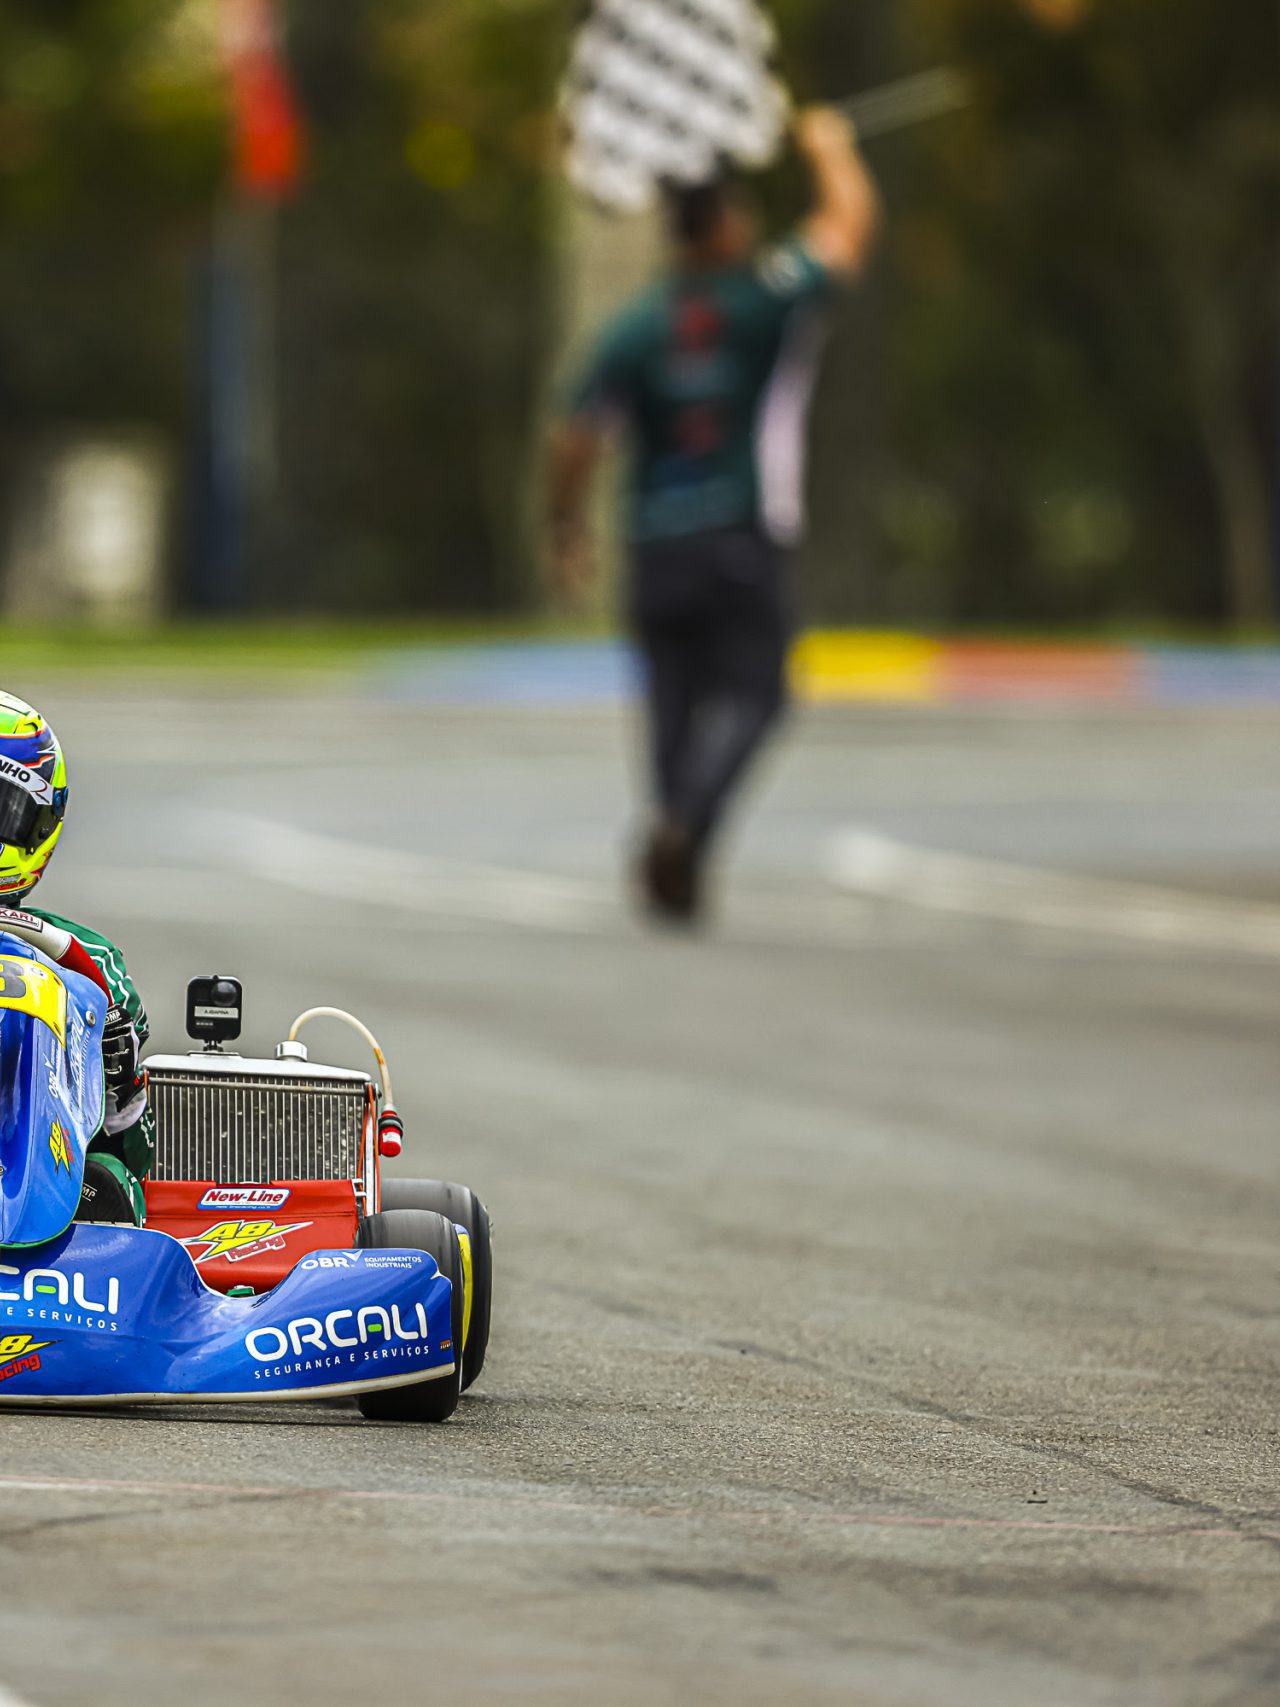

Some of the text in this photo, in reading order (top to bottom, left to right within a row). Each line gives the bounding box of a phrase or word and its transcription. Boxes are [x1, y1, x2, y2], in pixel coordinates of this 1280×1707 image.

[205, 1190, 284, 1202] New-Line
[301, 1257, 350, 1270] OBR
[7, 1306, 14, 1316] E
[27, 1308, 118, 1332] SERVIÇOS
[244, 1302, 429, 1362] ORCALI
[254, 1355, 341, 1380] SEGURANÇA
[349, 1353, 355, 1362] E
[363, 1345, 430, 1361] SERVIÇOS
